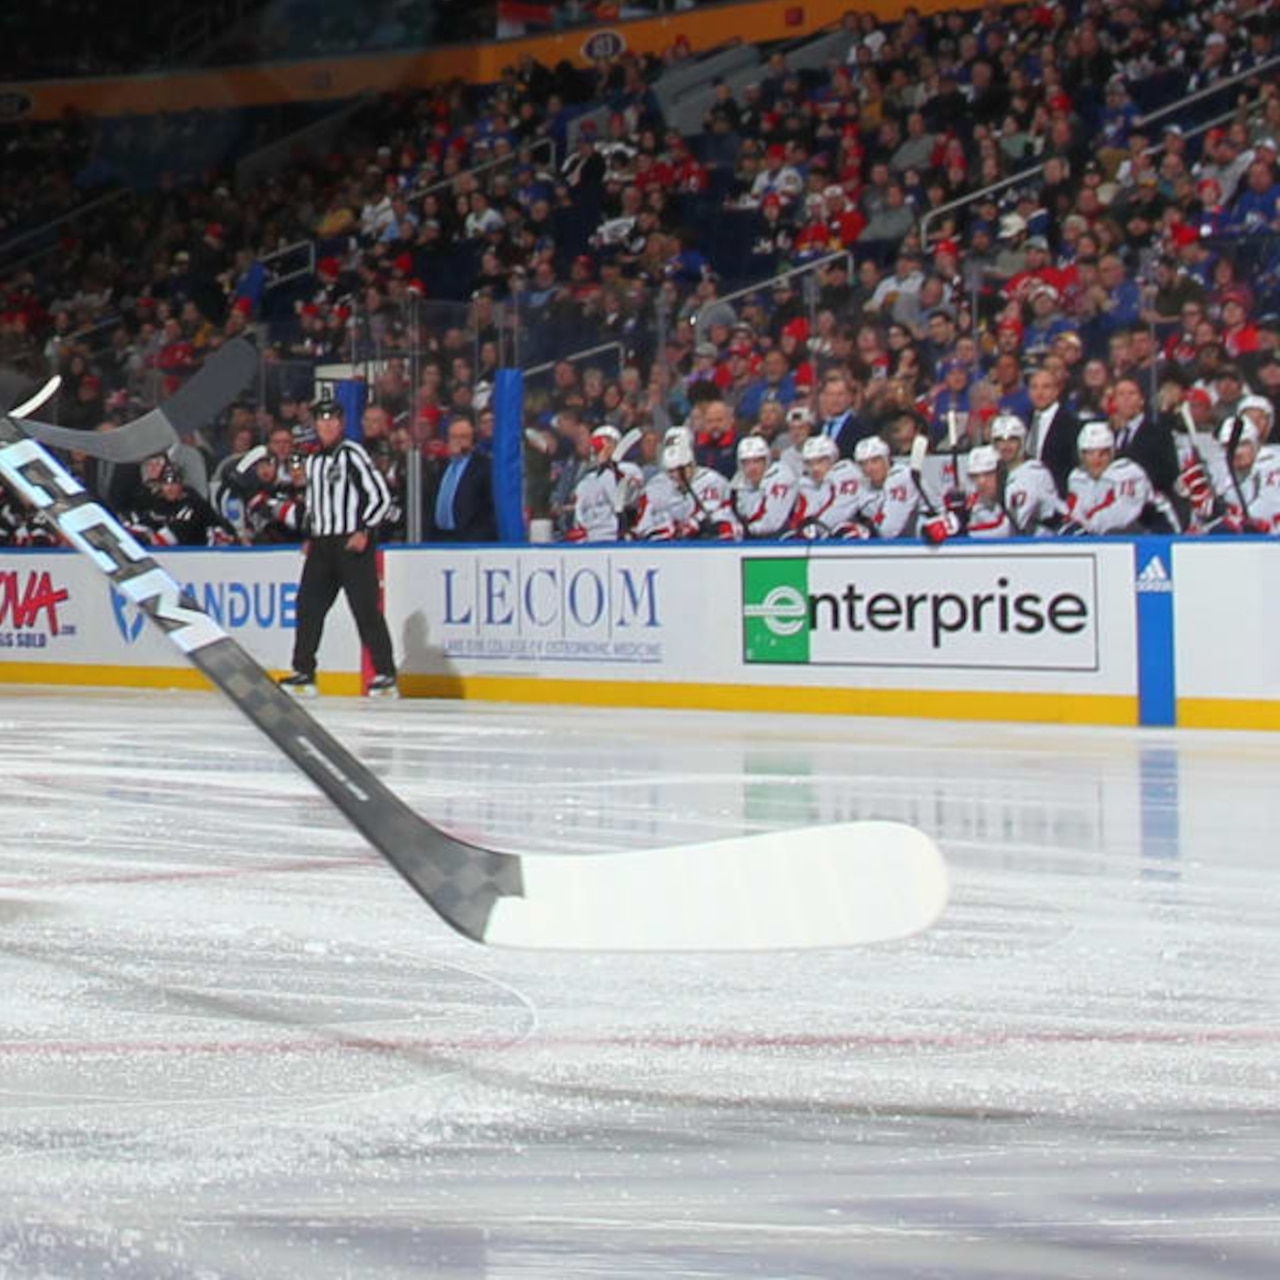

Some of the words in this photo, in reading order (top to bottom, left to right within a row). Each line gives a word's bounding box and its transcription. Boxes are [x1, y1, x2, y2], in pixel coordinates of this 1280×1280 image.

[442, 568, 663, 628] LECOM
[744, 577, 1088, 648] enterprise
[17, 633, 47, 648] SOLD
